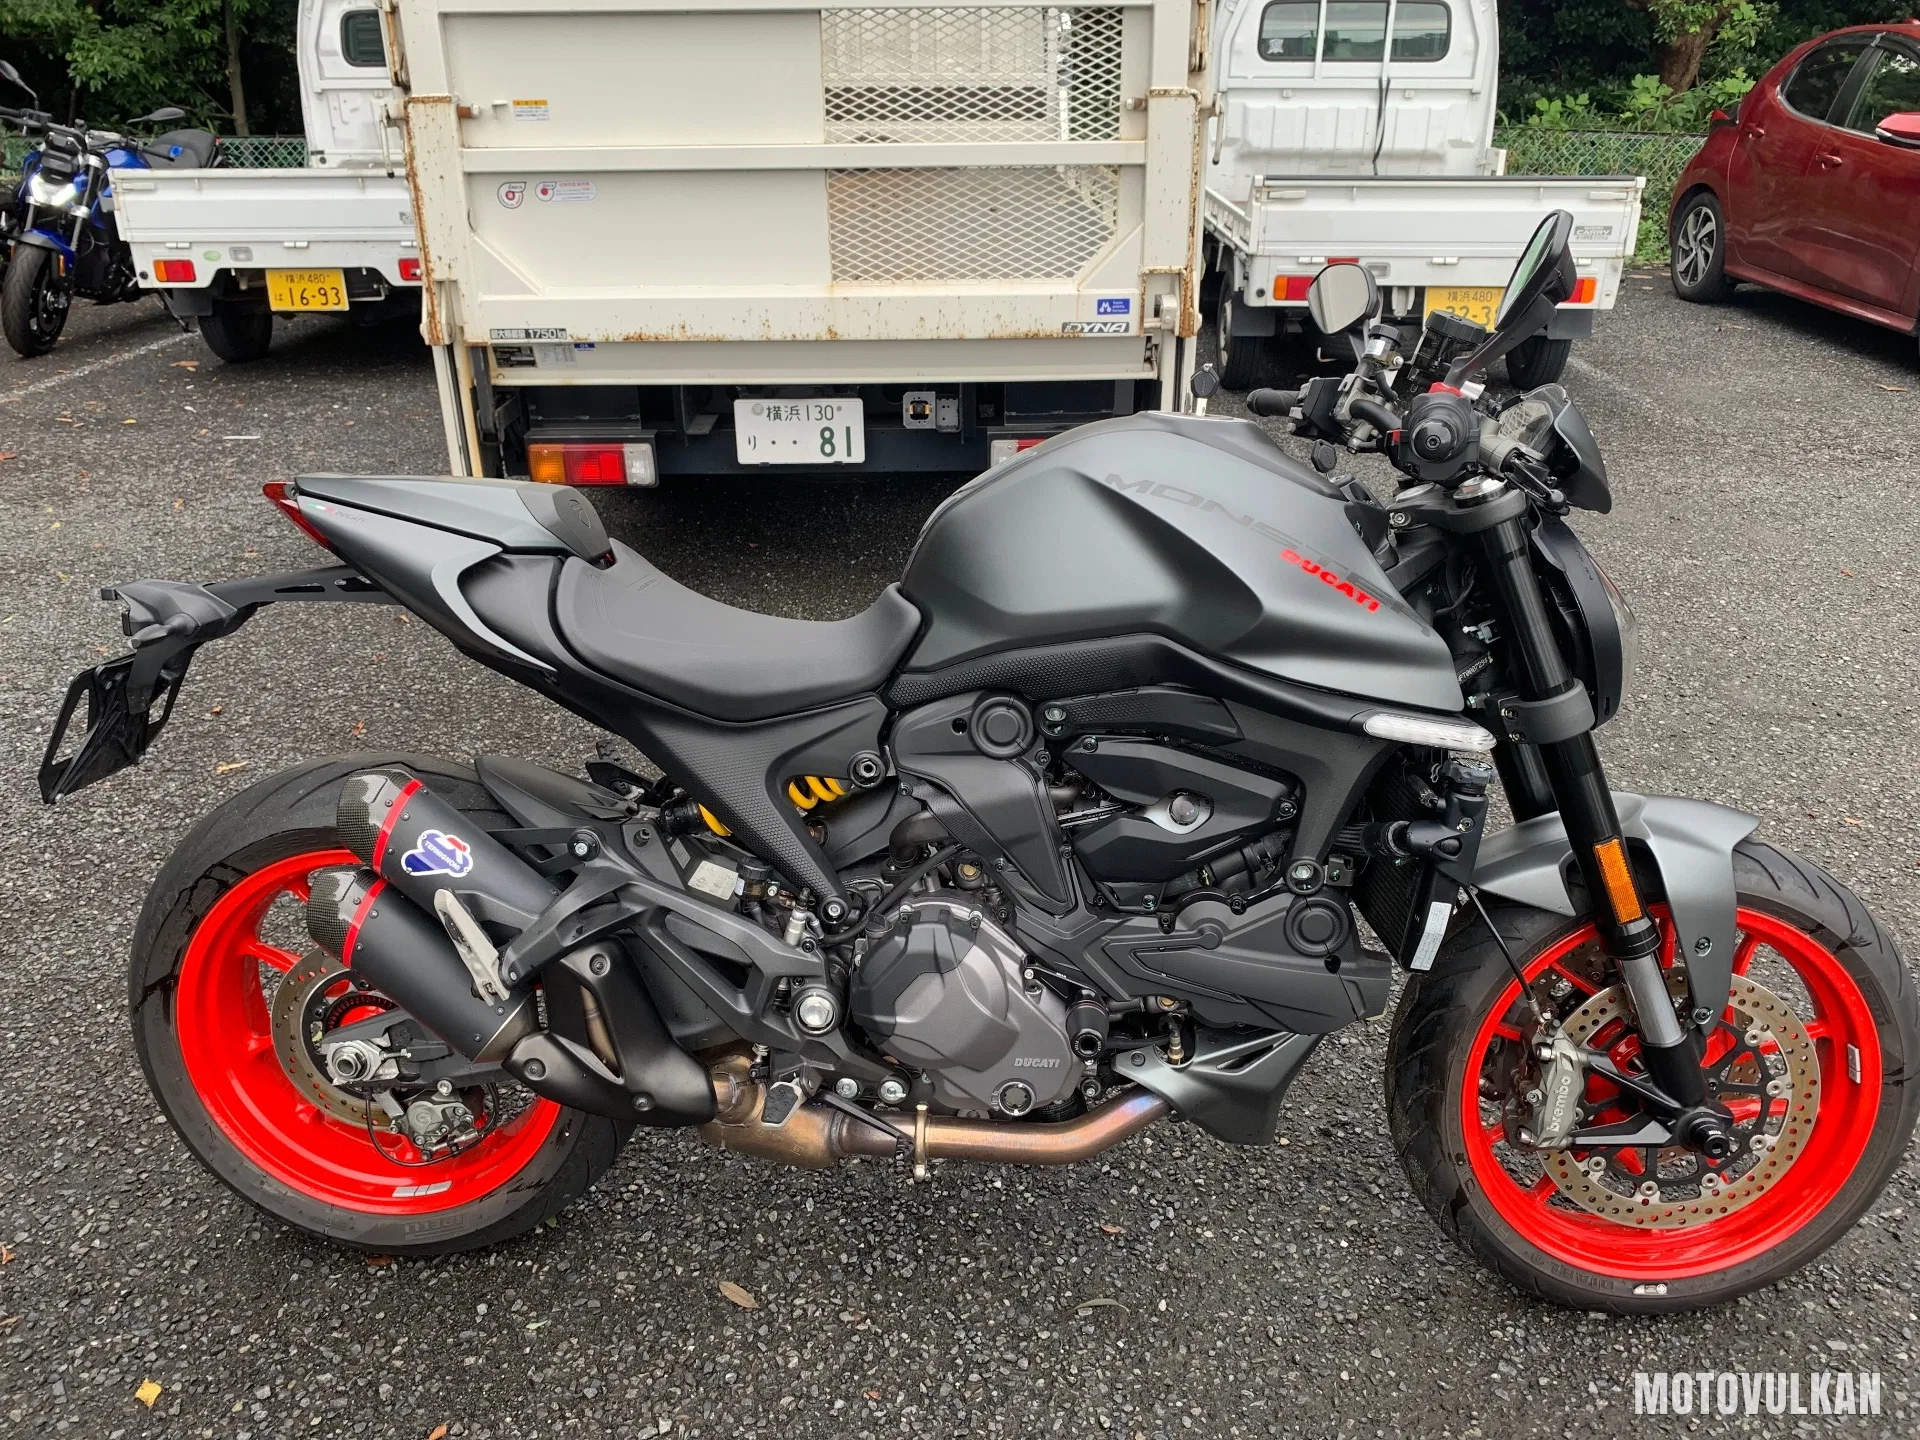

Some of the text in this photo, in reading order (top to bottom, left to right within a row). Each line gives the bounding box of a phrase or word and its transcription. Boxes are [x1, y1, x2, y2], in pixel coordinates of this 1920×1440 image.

[289, 286, 341, 306] 16-93
[1063, 322, 1128, 333] DYNA
[1103, 473, 1431, 638] MONSTER
[1279, 547, 1381, 614] DUCATI
[423, 839, 462, 872] TERMIGNONI
[1013, 1057, 1060, 1068] DUCATI
[1545, 1075, 1572, 1133] brembo
